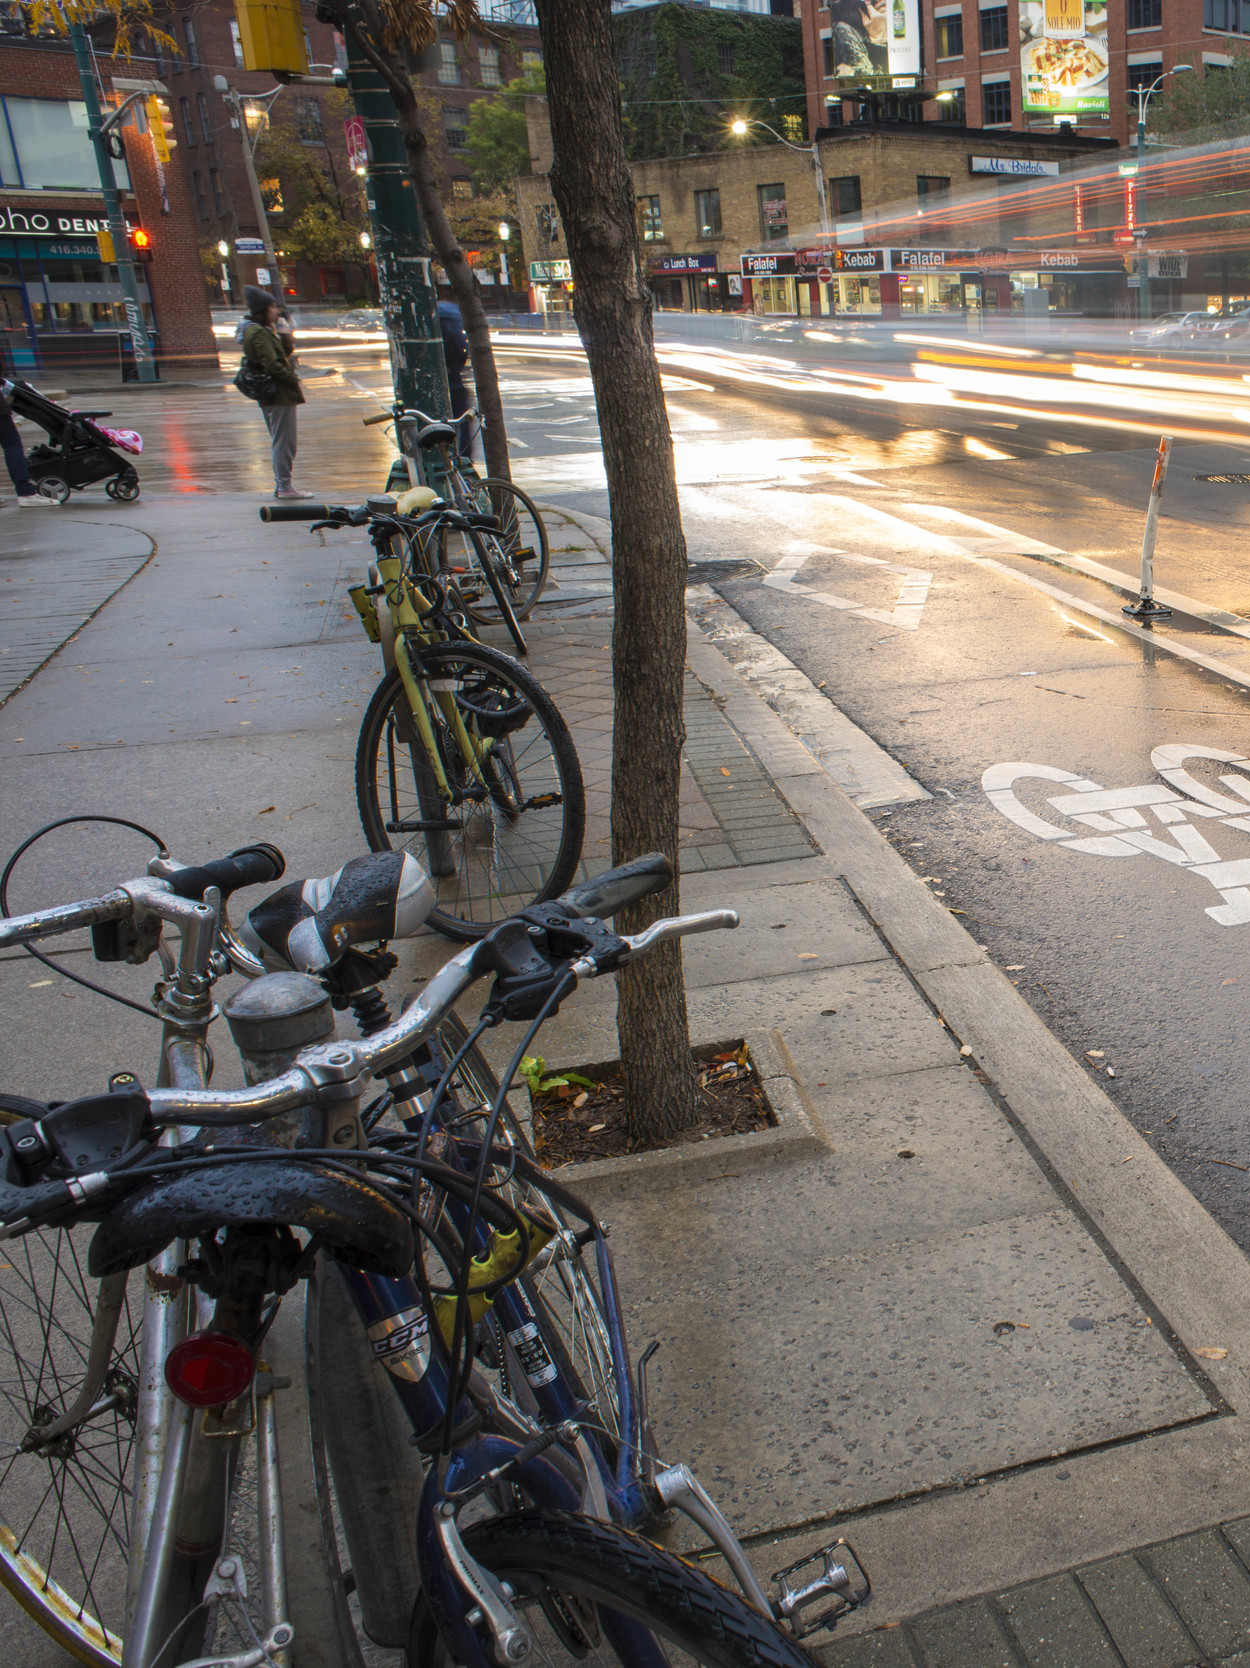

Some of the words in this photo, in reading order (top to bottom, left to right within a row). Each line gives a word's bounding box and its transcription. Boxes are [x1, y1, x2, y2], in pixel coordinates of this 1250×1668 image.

[1047, 16, 1065, 30] SOLE
[1066, 16, 1081, 30] MIO
[1077, 99, 1106, 109] Ravioli
[58, 218, 137, 232] DENTL
[671, 258, 687, 269] Lunch
[687, 257, 700, 268] Box
[747, 256, 778, 271] Falafel
[843, 252, 876, 267] Kebab
[901, 251, 946, 266] Falafel
[1040, 253, 1079, 267] Kebab
[373, 1319, 428, 1354] CCM
[390, 1344, 425, 1366] BIKES
[459, 1560, 484, 1595] PROMAX
